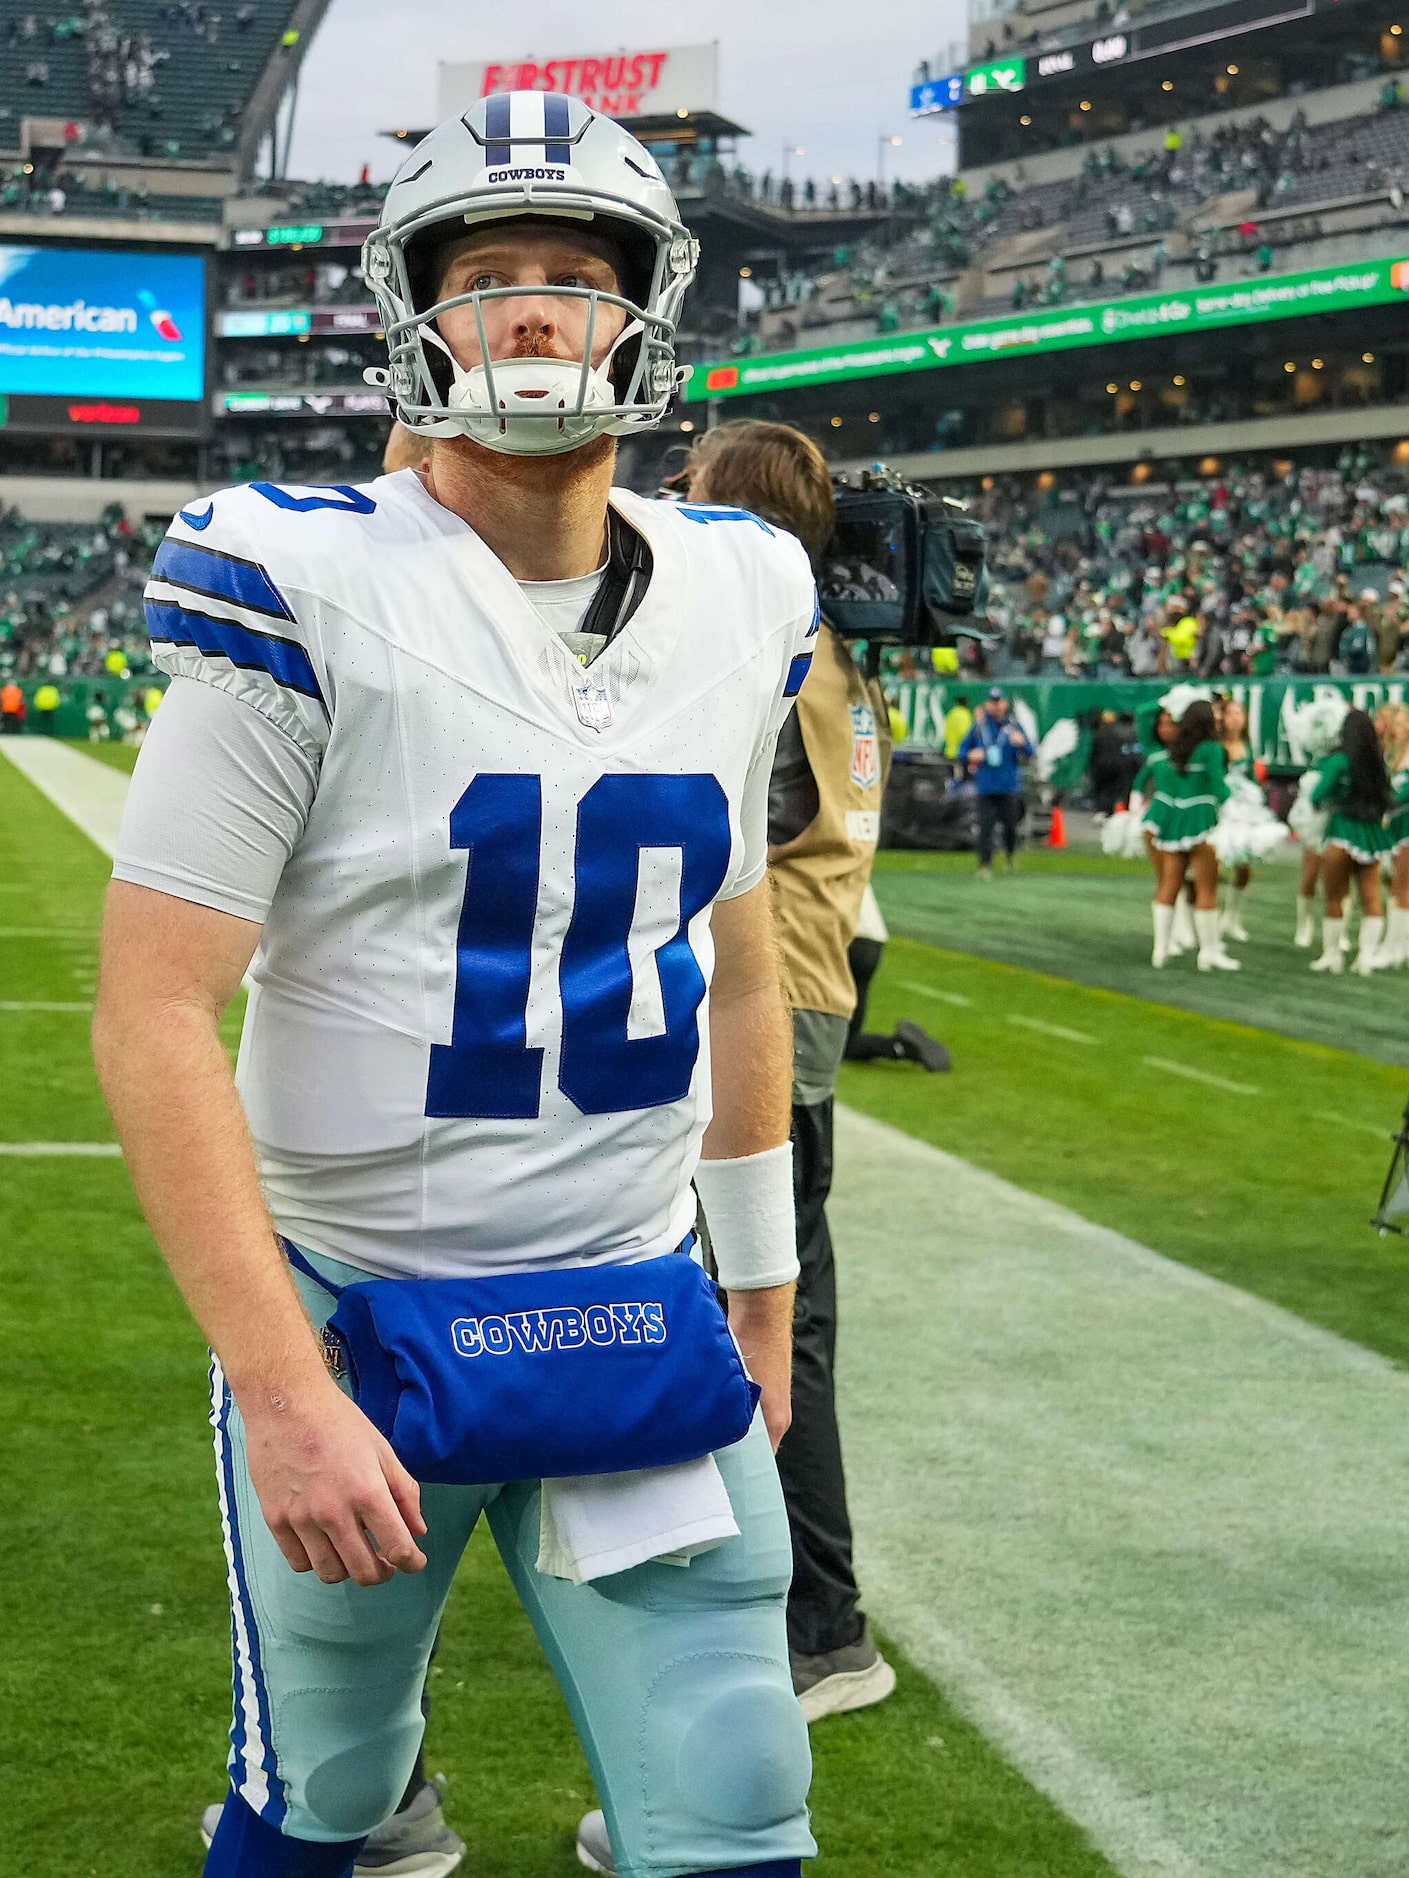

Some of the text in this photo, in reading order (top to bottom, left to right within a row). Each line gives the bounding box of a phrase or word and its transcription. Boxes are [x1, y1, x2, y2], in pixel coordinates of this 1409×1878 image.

[585, 93, 644, 114] ANK
[488, 168, 565, 183] COWBOYS
[424, 773, 731, 1119] 10
[451, 1302, 667, 1357] COWBOYS
